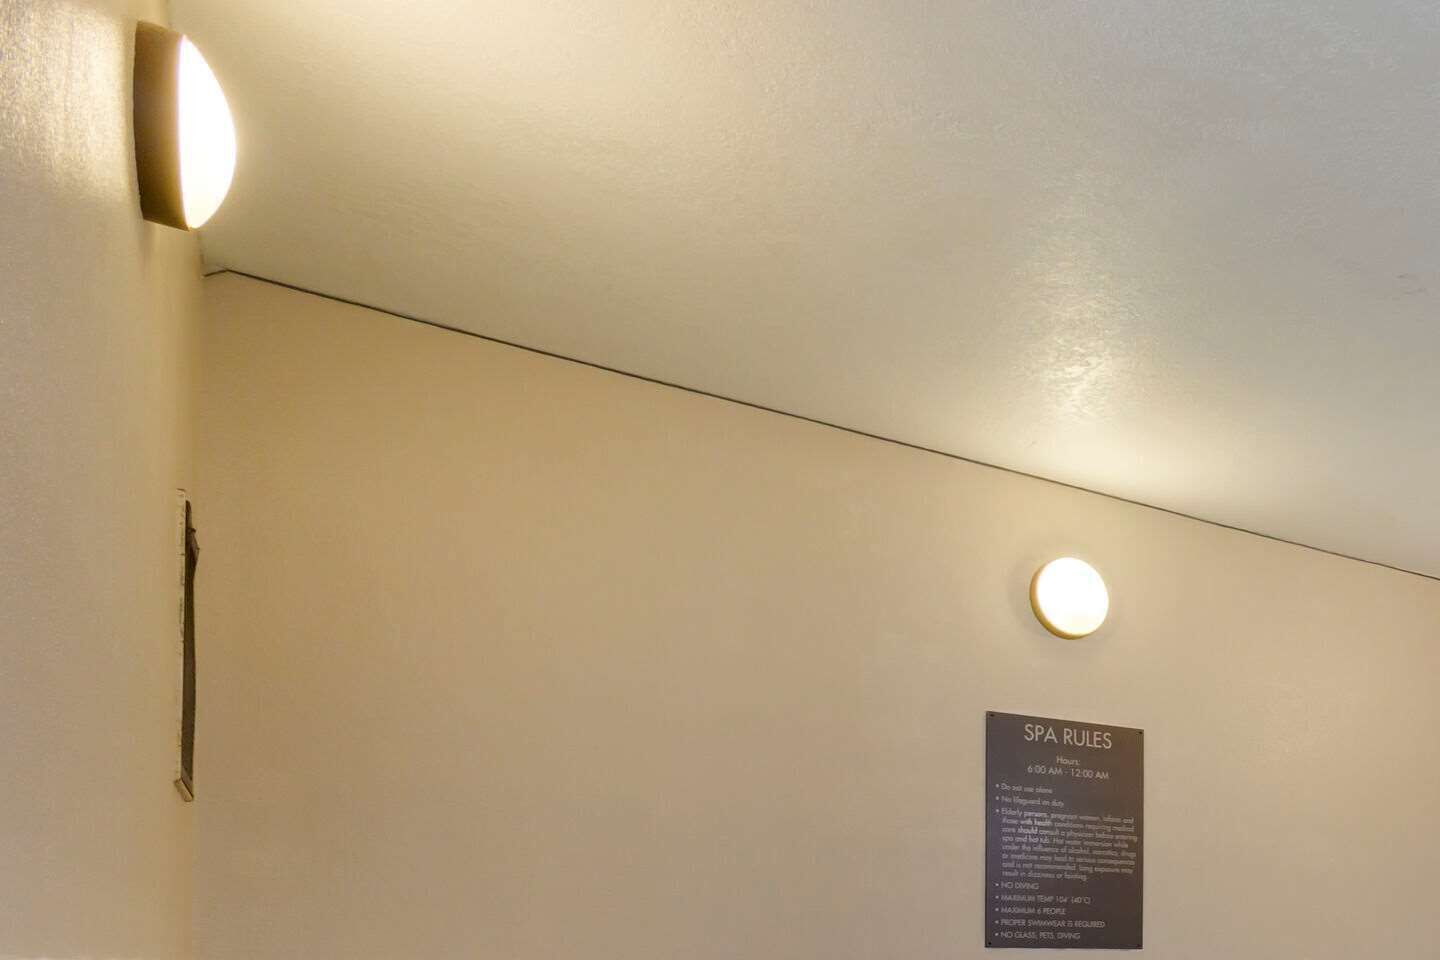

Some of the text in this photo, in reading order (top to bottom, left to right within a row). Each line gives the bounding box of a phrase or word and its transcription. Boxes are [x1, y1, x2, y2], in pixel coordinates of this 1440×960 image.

[1024, 724, 1112, 749] SPA RULES
[1048, 766, 1063, 776] AM
[1096, 770, 1110, 780] AM
[1014, 882, 1040, 890] DIVING
[1043, 908, 1066, 916] PEOPLE
[1001, 931, 1013, 939] NO
